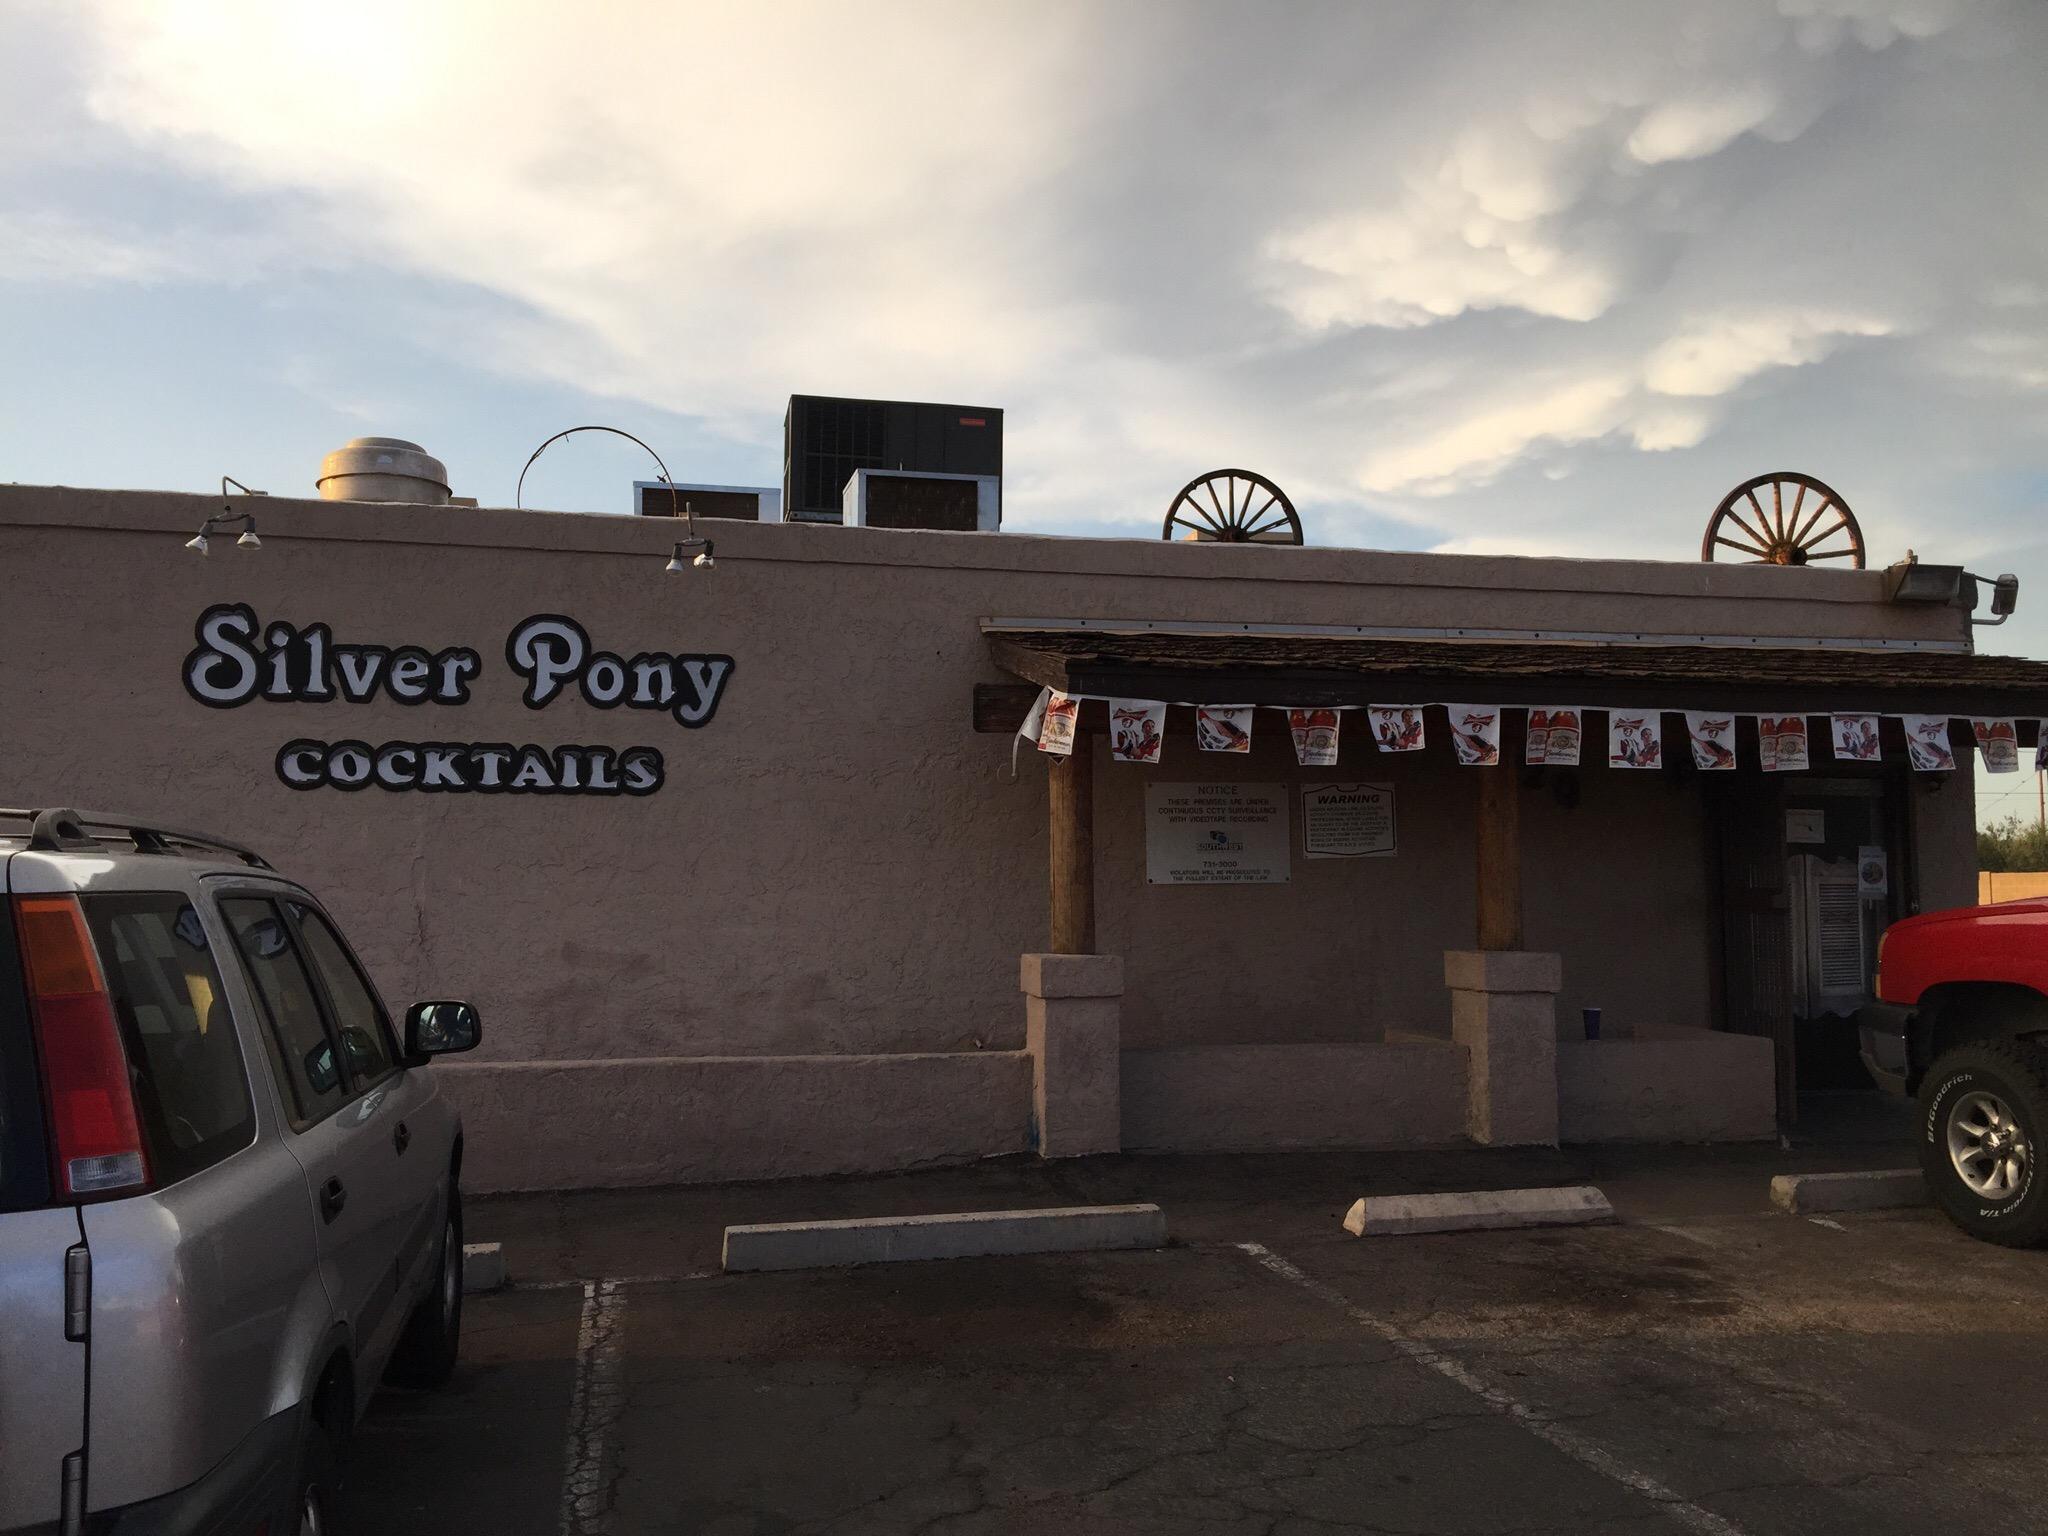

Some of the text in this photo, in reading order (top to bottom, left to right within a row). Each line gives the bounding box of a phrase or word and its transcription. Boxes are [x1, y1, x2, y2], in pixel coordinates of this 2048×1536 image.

[186, 608, 731, 725] Silver Pony
[279, 744, 661, 791] COCKTAILS
[1198, 785, 1239, 795] NOTICE
[1168, 798, 1270, 806] THESE PREMISES ARE UNDER
[1318, 794, 1380, 804] WARNING
[1158, 807, 1278, 815] CONTINUOUS CCTV SURVEILLANCE
[1229, 816, 1270, 824] RECORDING
[1927, 1072, 1973, 1143] BFGoodrich
